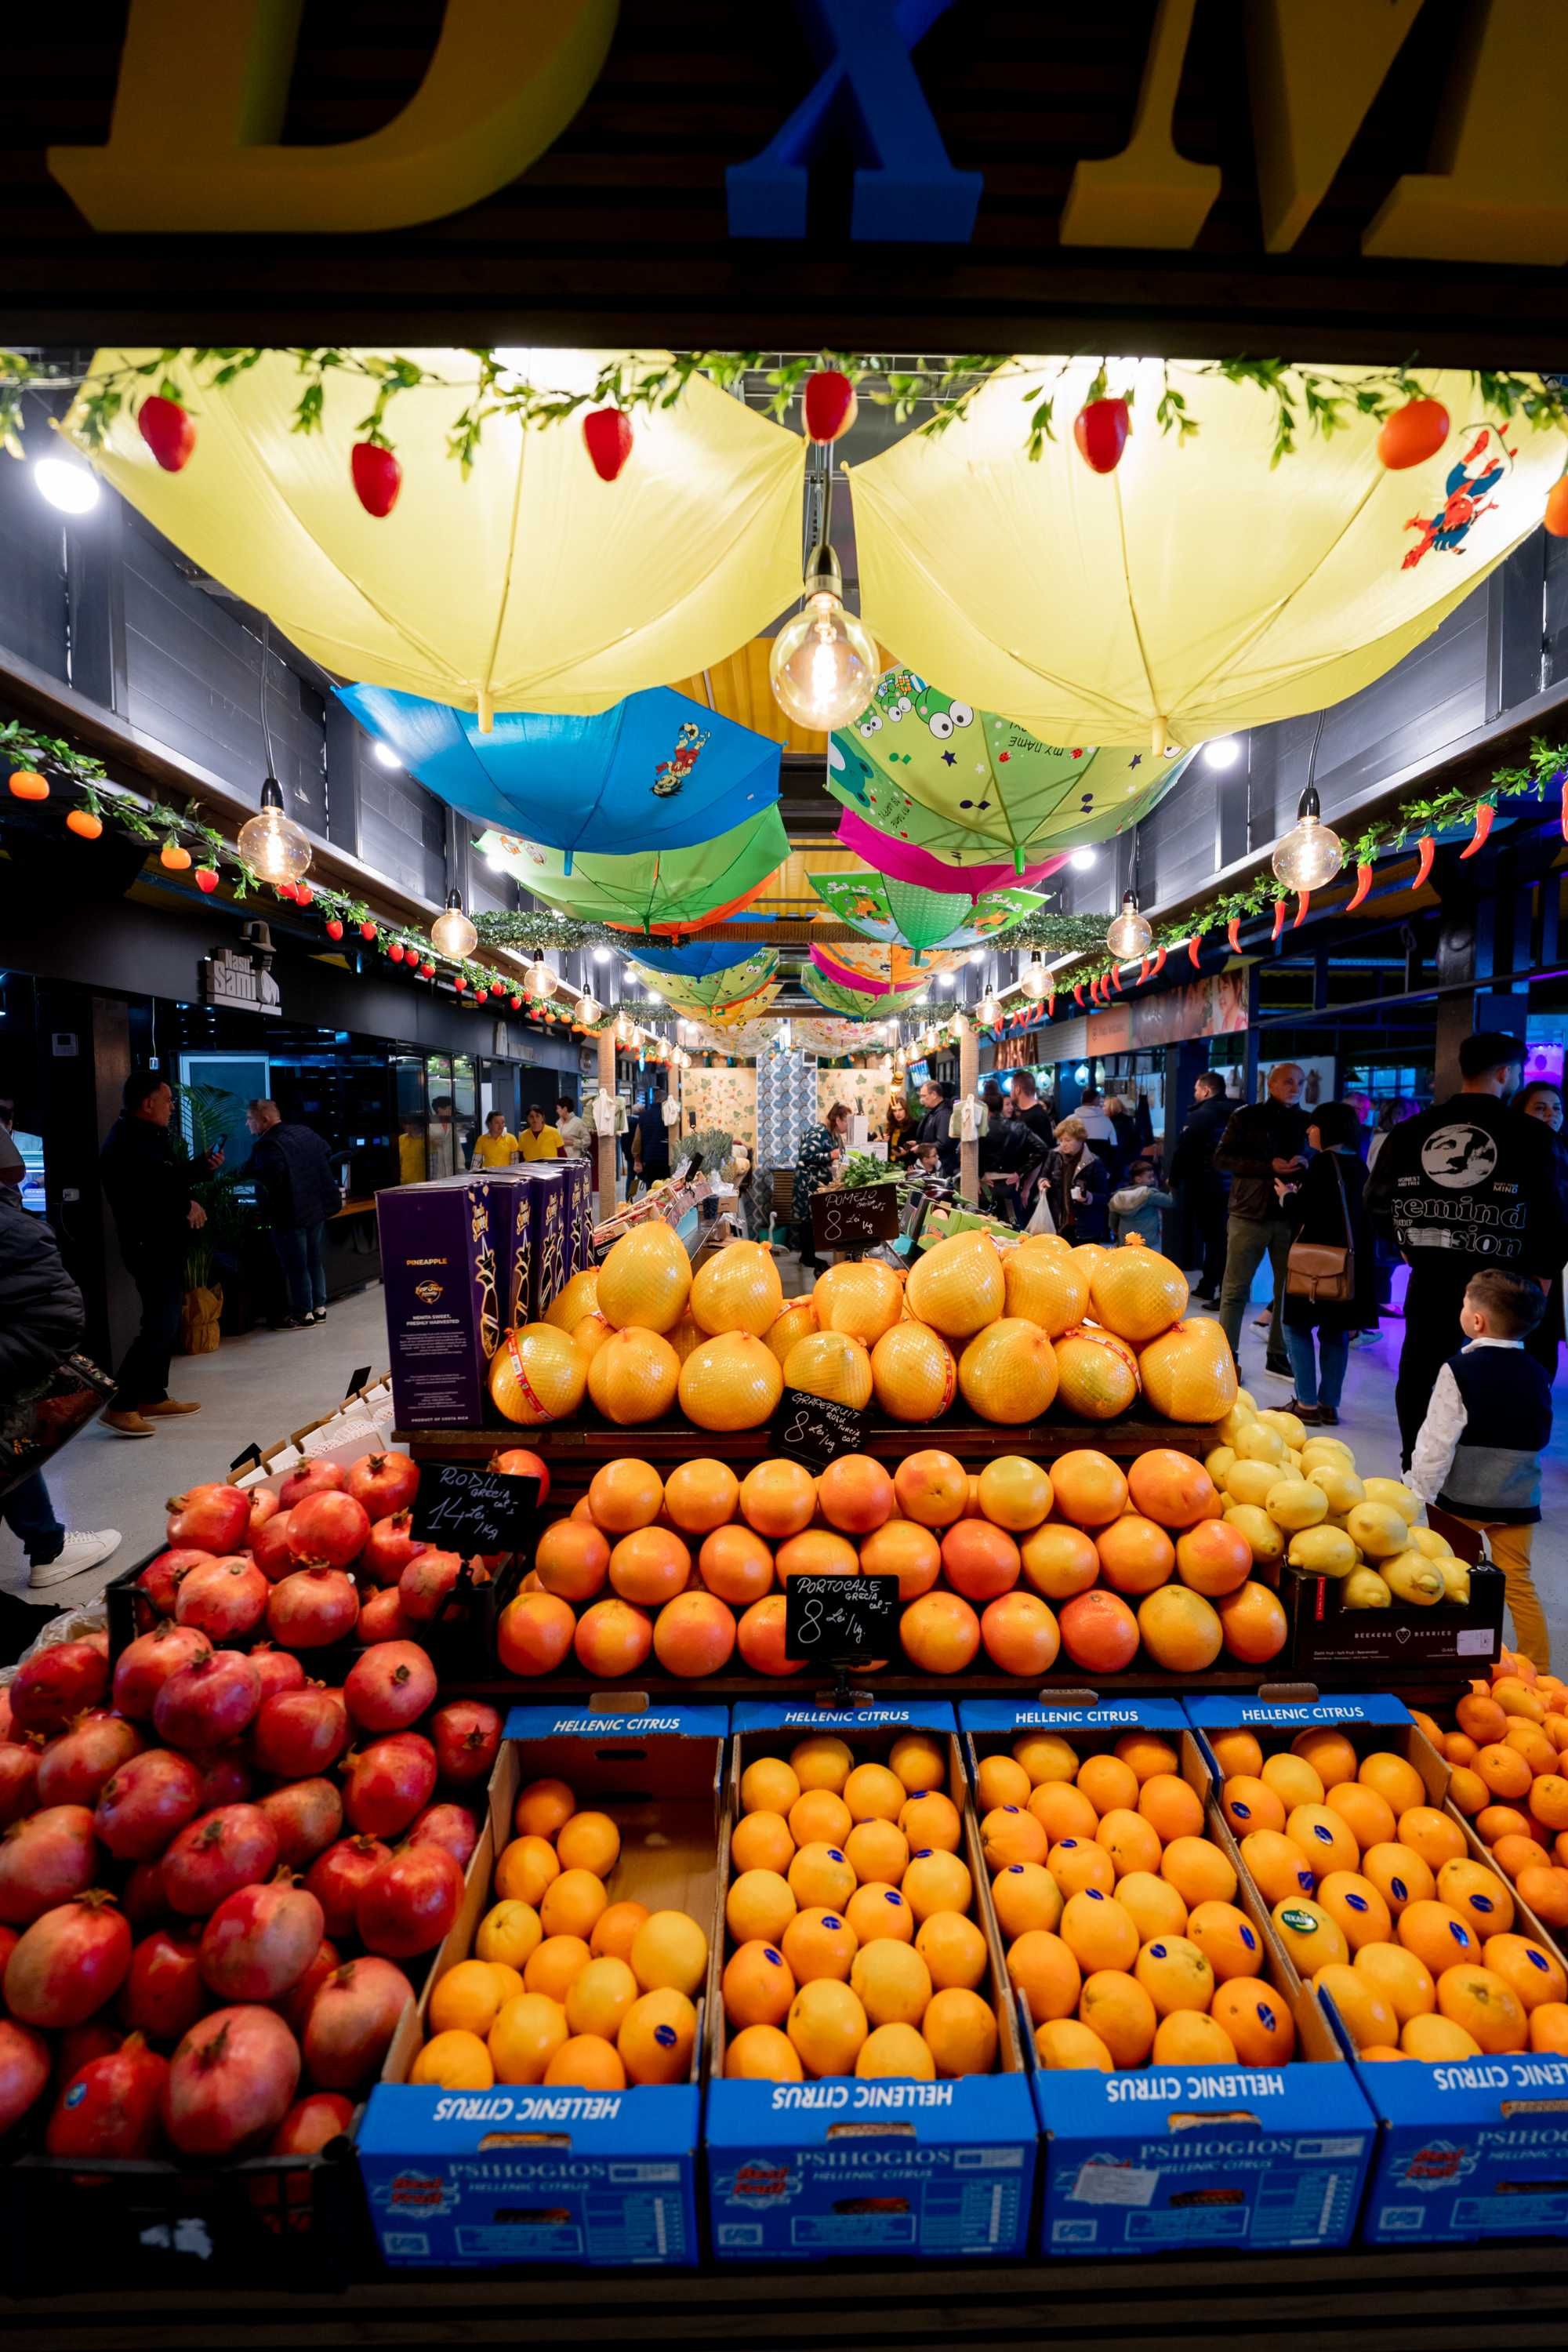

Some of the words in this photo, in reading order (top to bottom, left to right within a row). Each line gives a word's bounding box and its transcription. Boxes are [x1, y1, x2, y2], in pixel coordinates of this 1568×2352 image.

[213, 960, 257, 1002] Sami
[826, 1189, 878, 1207] POMELO
[1493, 1185, 1519, 1193] MIND
[1392, 1196, 1527, 1229] remind
[824, 1210, 842, 1240] 8
[791, 1392, 861, 1420] GRAPEFRUIT
[784, 1411, 810, 1443] 8
[426, 1497, 465, 1530] 14
[797, 1577, 883, 1594] PORTOCALE
[797, 1599, 823, 1644] 8
[553, 1719, 625, 1732] HELLENIC
[626, 1718, 681, 1730] CITRUS
[785, 1712, 854, 1722] HELLENIC
[858, 1711, 909, 1722] CITRUS
[1015, 1711, 1083, 1723] HELLENIC
[1087, 1711, 1138, 1722] CITRUS
[1242, 1708, 1309, 1720] HELLENIC
[1312, 1707, 1364, 1719] CITRUS
[1186, 2074, 1284, 2100] HELLENIC
[1433, 2066, 1509, 2090] CITRUS
[772, 2086, 849, 2109] CITRUS
[853, 2085, 953, 2108] HELLENIC
[1105, 2078, 1181, 2103] CITRUS
[433, 2098, 514, 2121] CITRUS
[515, 2097, 622, 2121] HELLENIC
[796, 2149, 951, 2167] PSIHOGIOS
[1140, 2139, 1293, 2159] PSIHOGIOS
[448, 2163, 605, 2179] PSIHOGIOS
